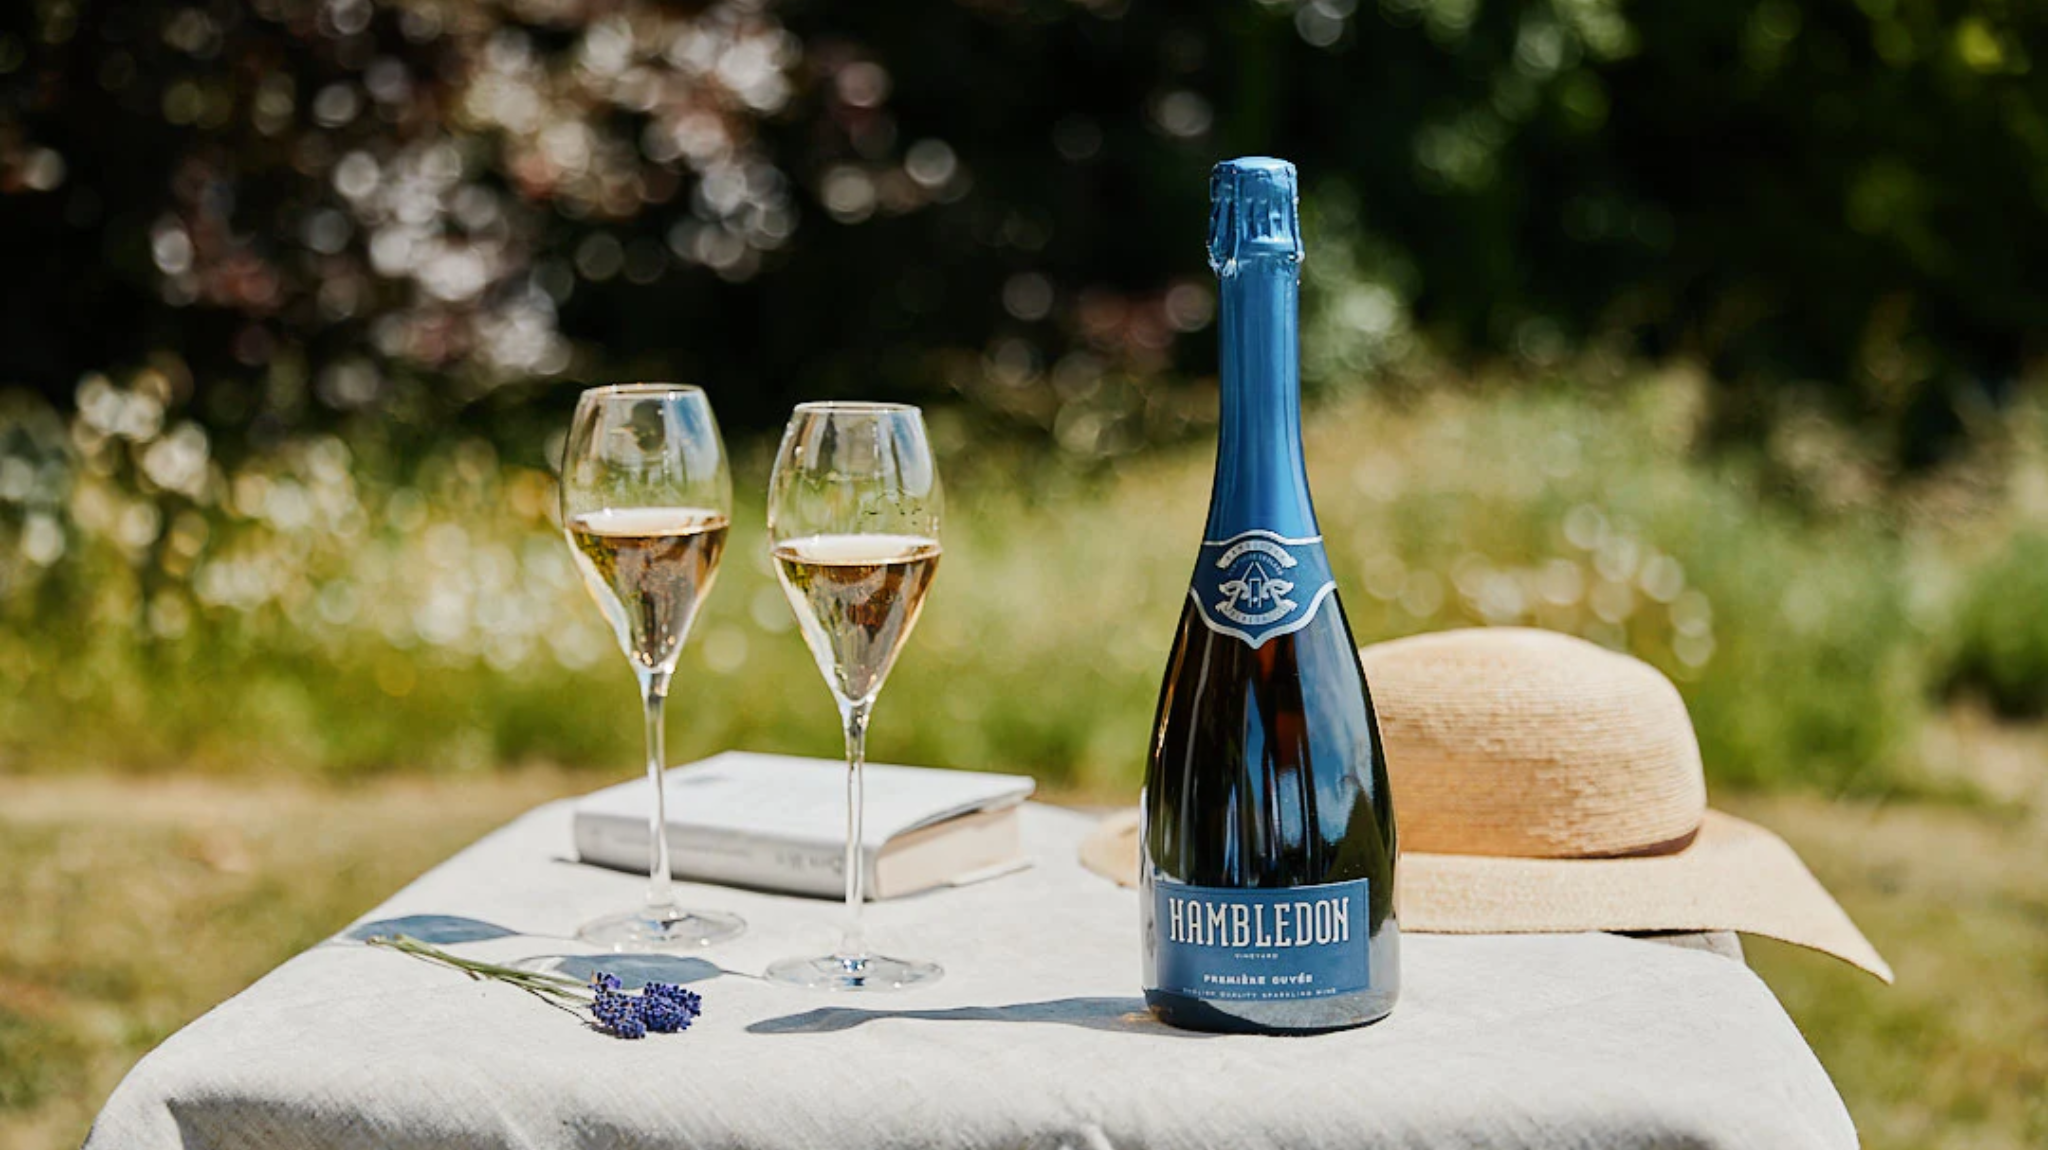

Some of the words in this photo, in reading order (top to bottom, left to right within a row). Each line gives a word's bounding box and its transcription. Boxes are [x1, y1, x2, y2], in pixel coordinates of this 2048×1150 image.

[1168, 896, 1350, 948] HAMBLEDON
[1203, 973, 1266, 985] PREMIÈRE
[1271, 972, 1314, 984] CUVÉE
